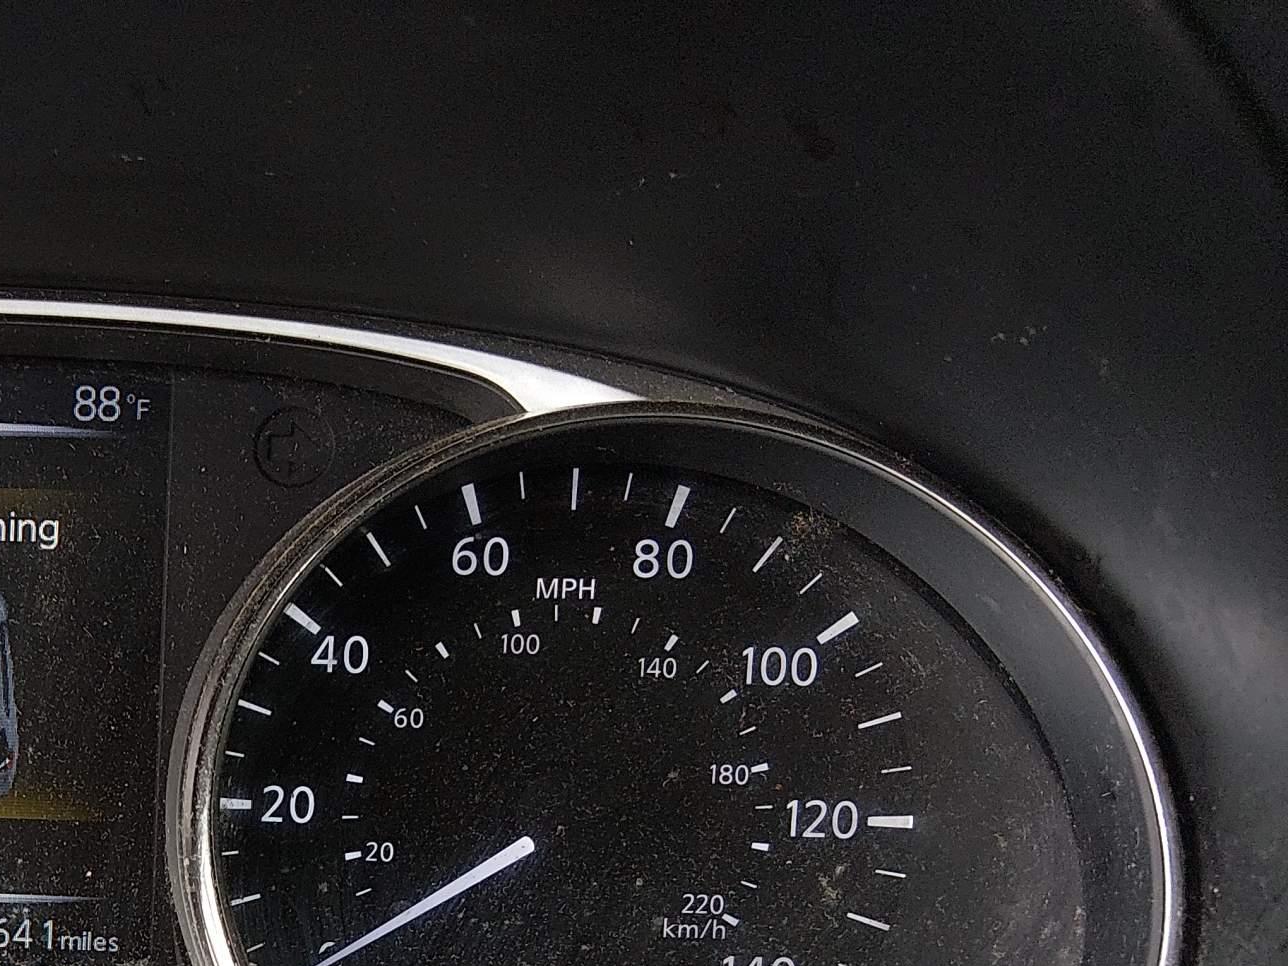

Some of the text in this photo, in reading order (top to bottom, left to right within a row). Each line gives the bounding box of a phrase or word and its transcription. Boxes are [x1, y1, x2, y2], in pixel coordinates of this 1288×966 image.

[452, 536, 510, 576] 60
[632, 538, 693, 579] 80
[536, 577, 596, 600] MPH
[310, 635, 369, 674] 40
[501, 633, 540, 655] 100
[638, 657, 677, 679] 140
[742, 646, 818, 687] 100
[394, 707, 424, 729] 60
[710, 764, 749, 786] 180
[261, 785, 315, 824] 20
[786, 799, 859, 839] 120
[365, 841, 394, 863] 20
[681, 893, 725, 915] 220
[663, 917, 727, 940] km/h
[60, 930, 119, 952] miles
